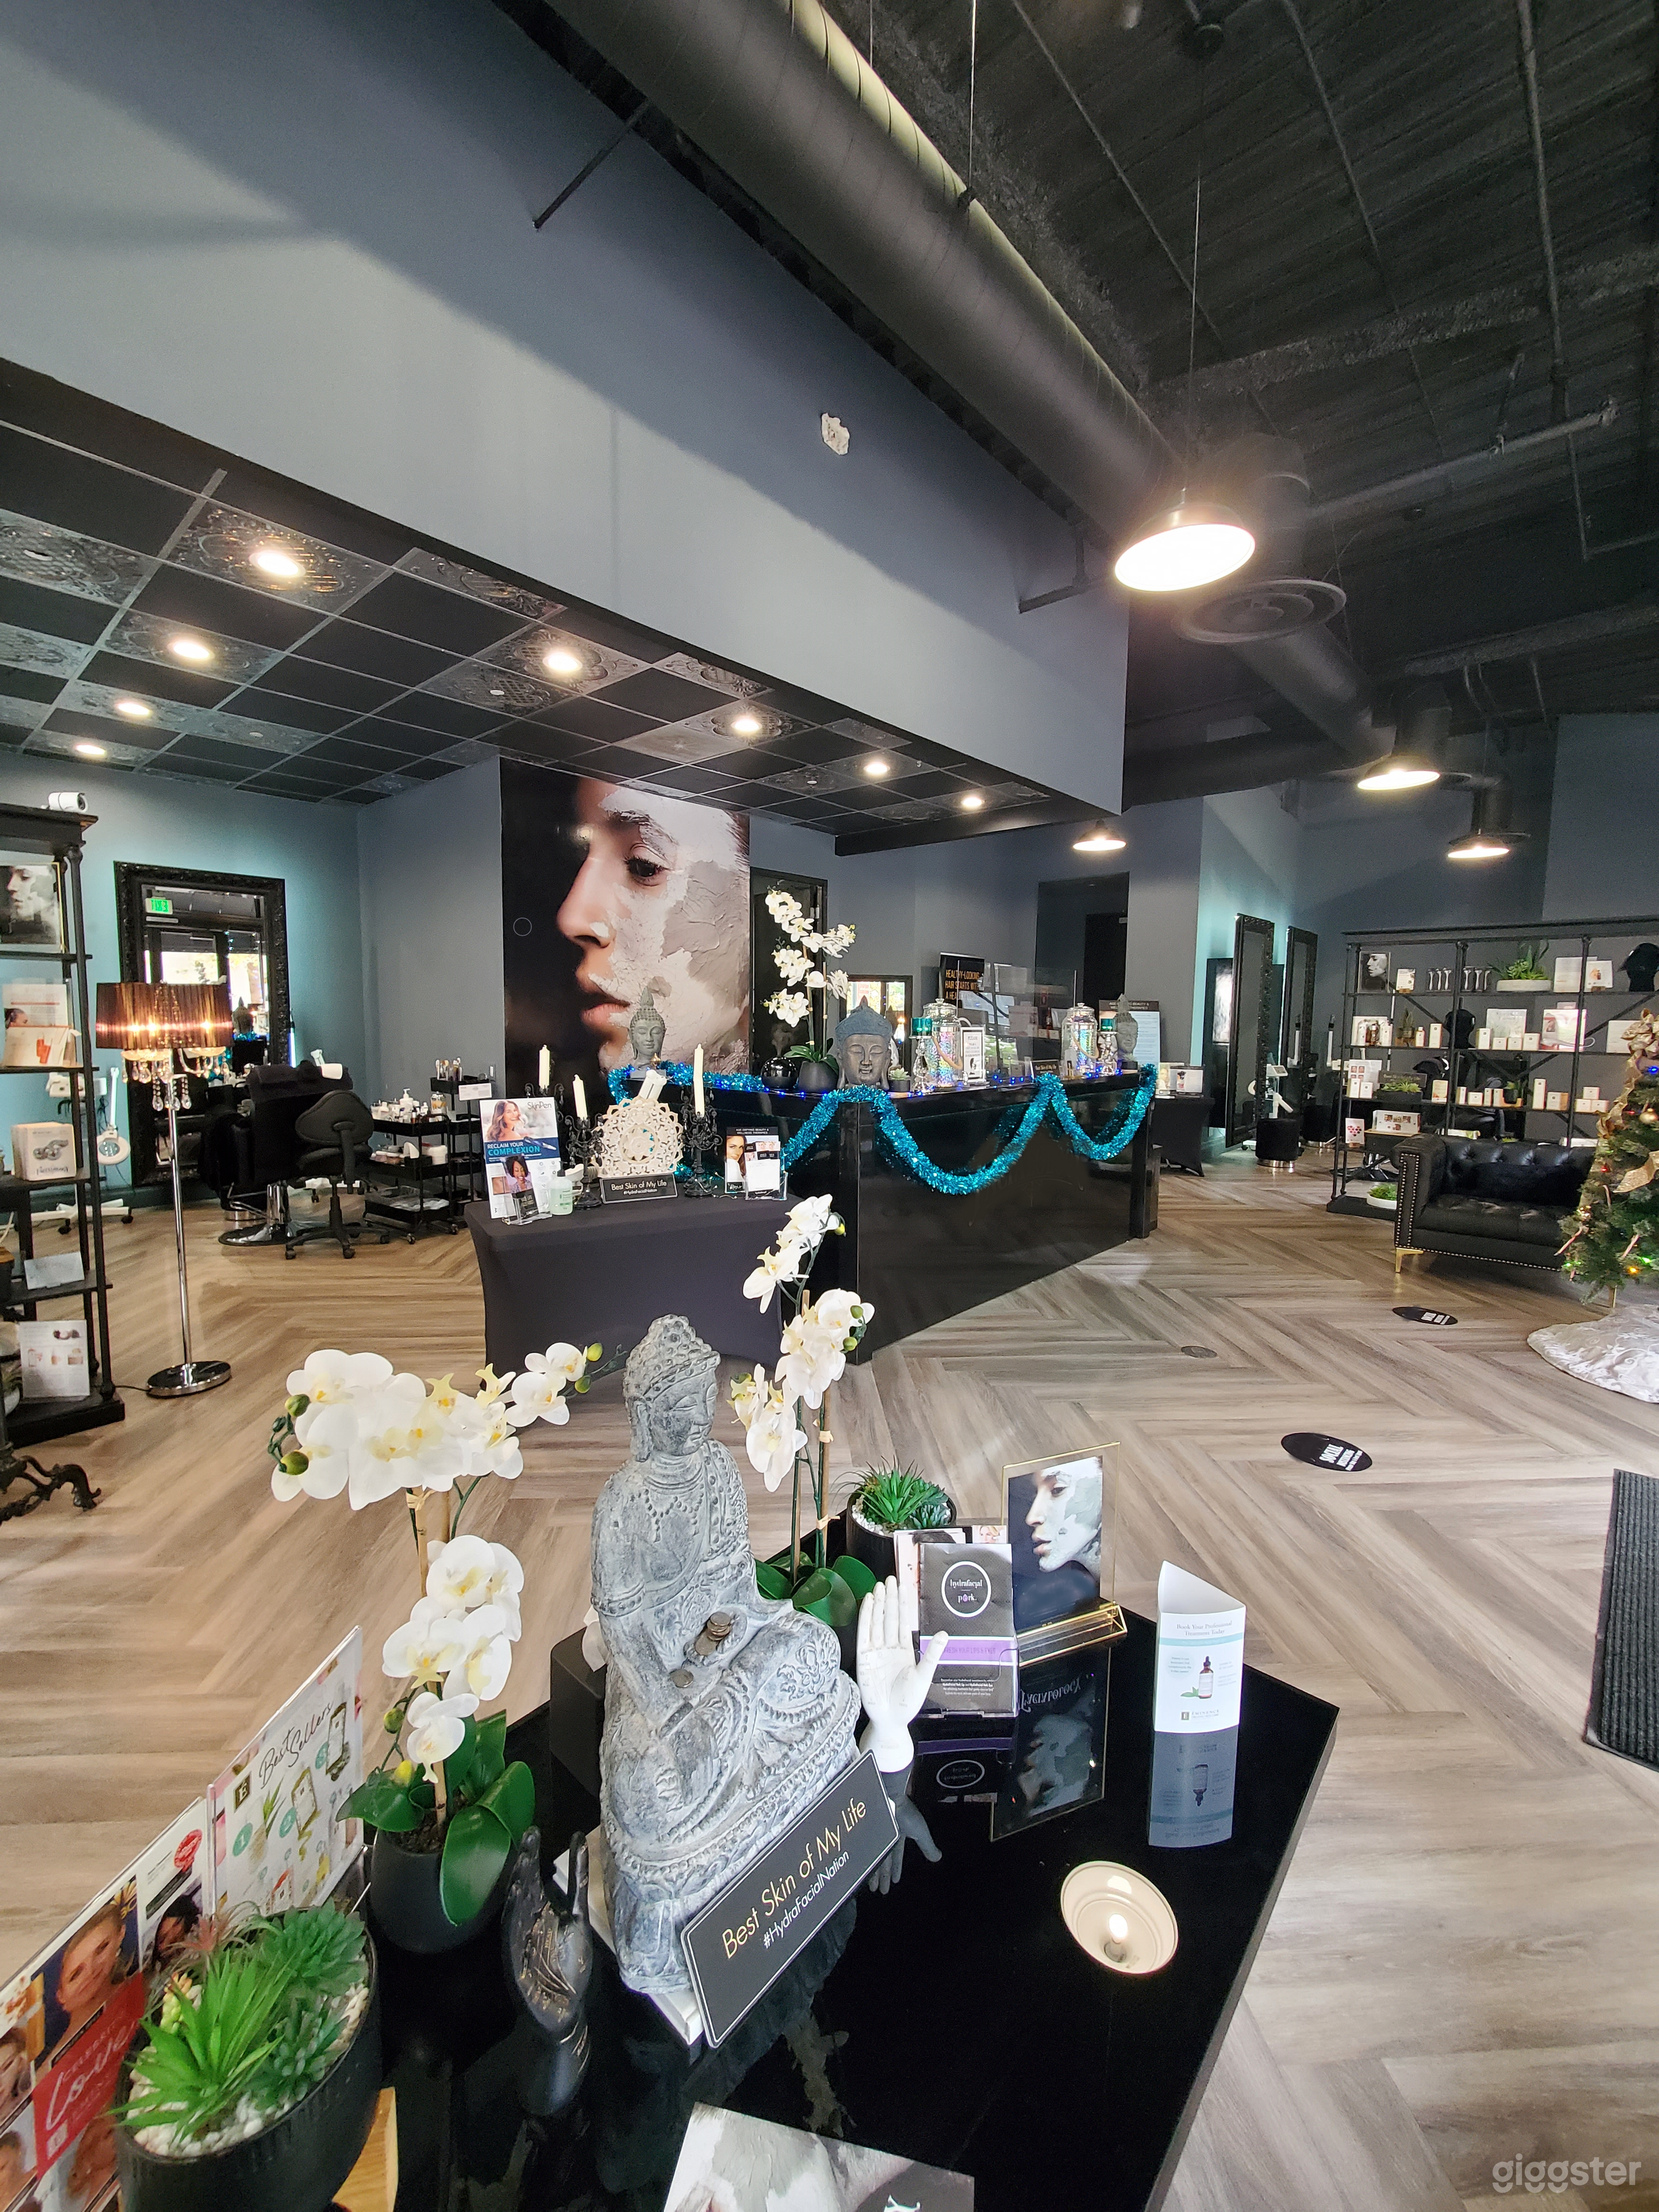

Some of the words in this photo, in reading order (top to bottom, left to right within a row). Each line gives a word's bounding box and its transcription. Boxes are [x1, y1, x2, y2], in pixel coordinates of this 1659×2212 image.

[945, 980, 955, 989] HAIR
[955, 981, 969, 990] STARTS
[527, 1101, 552, 1111] SkinPen
[488, 1146, 540, 1156] COMPLEXION
[950, 1579, 983, 1589] hydrafacial
[1205, 1620, 1232, 1629] Professional
[288, 1701, 334, 1767] Sellers
[259, 1726, 295, 1789] Best
[722, 1908, 759, 1959] Best
[762, 1875, 796, 1916] Skin
[799, 1843, 814, 1878] of
[816, 1825, 840, 1861] My
[842, 1798, 866, 1832] Life
[763, 1851, 849, 1949] #HydraFacialNation
